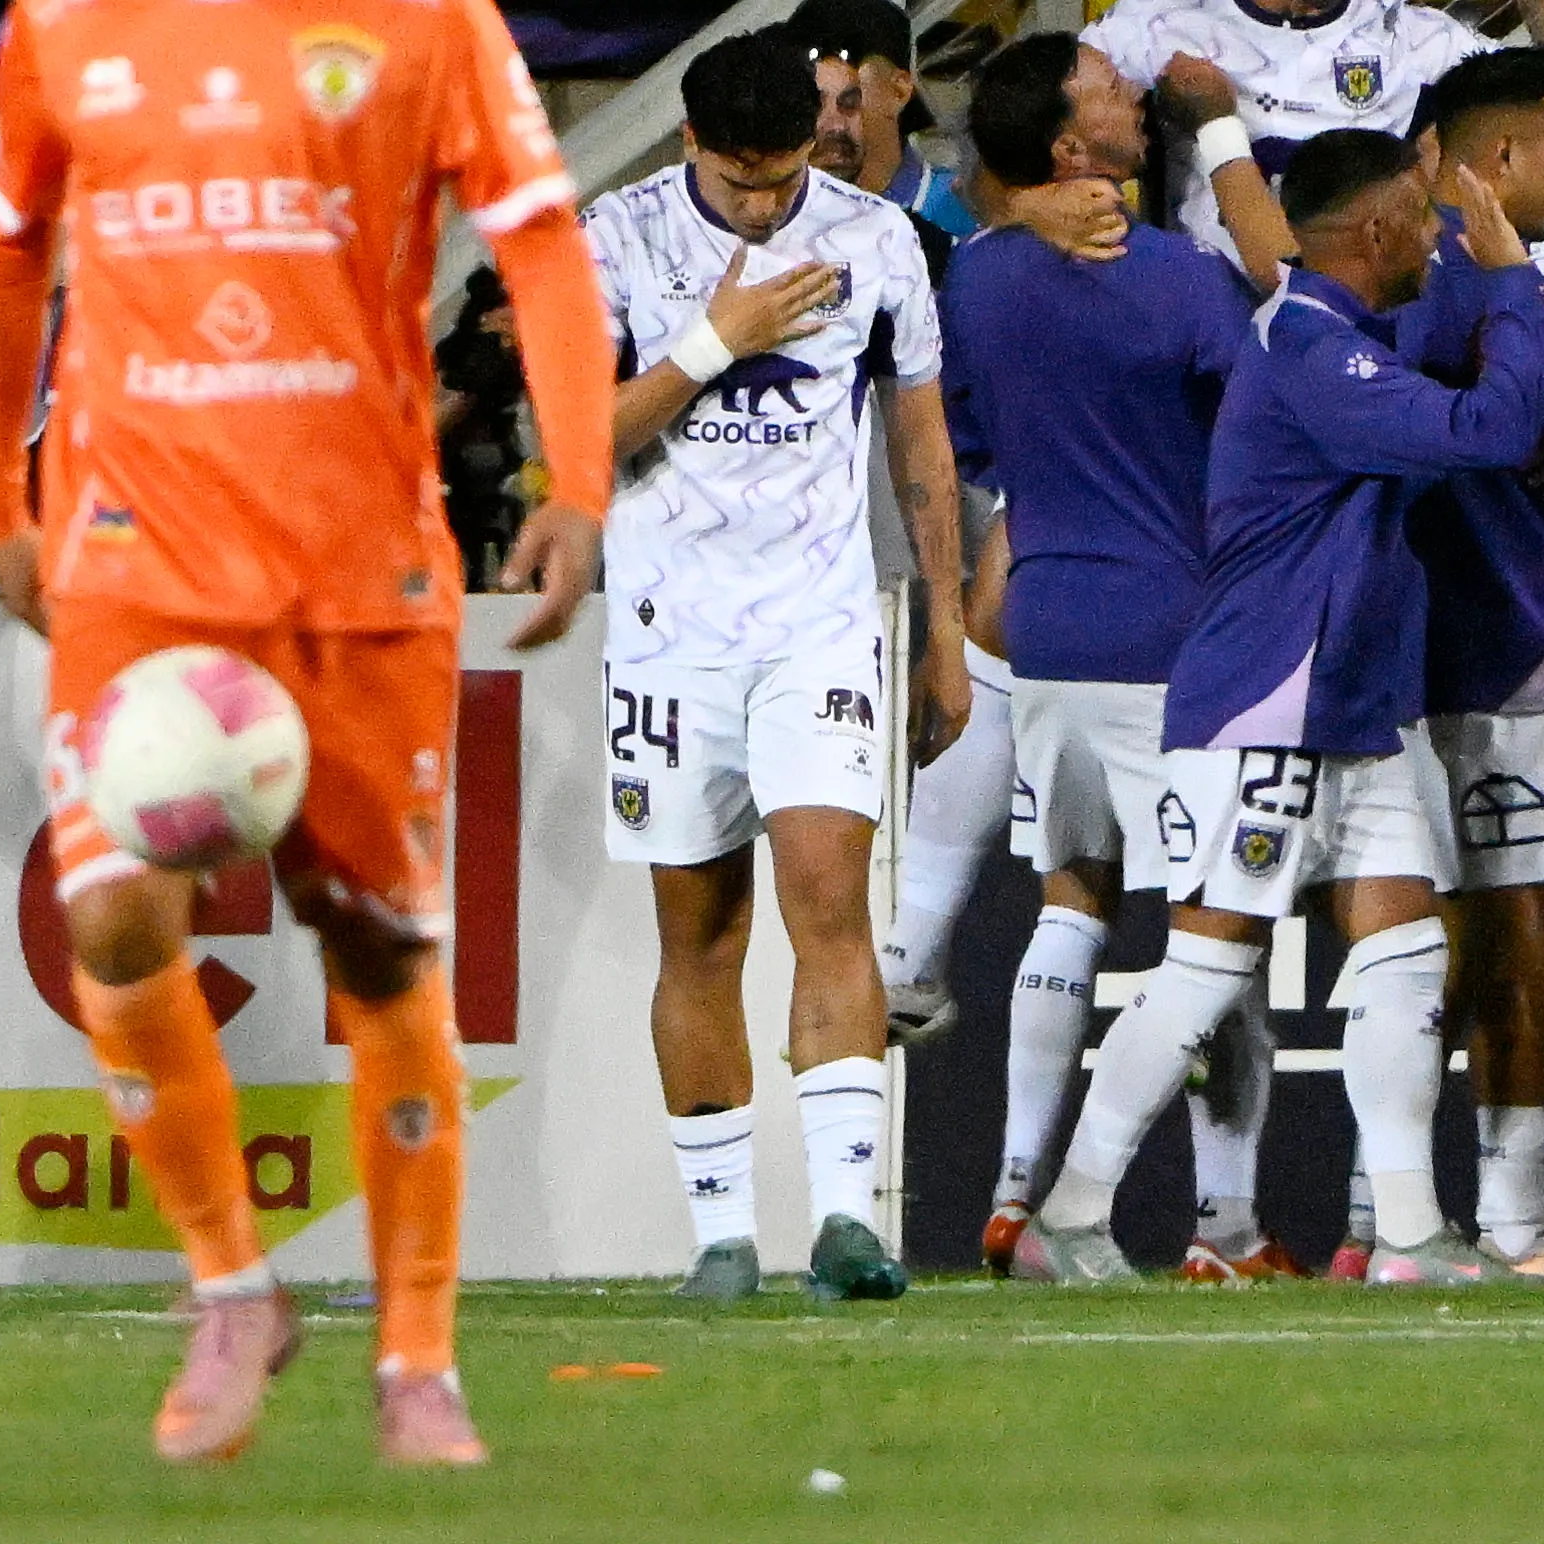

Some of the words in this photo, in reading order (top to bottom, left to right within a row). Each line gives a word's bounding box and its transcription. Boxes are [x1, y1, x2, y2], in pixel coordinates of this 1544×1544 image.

[660, 292, 699, 301] KELME
[683, 419, 818, 445] COOLBET
[611, 687, 679, 768] 24
[1239, 747, 1322, 820] 23
